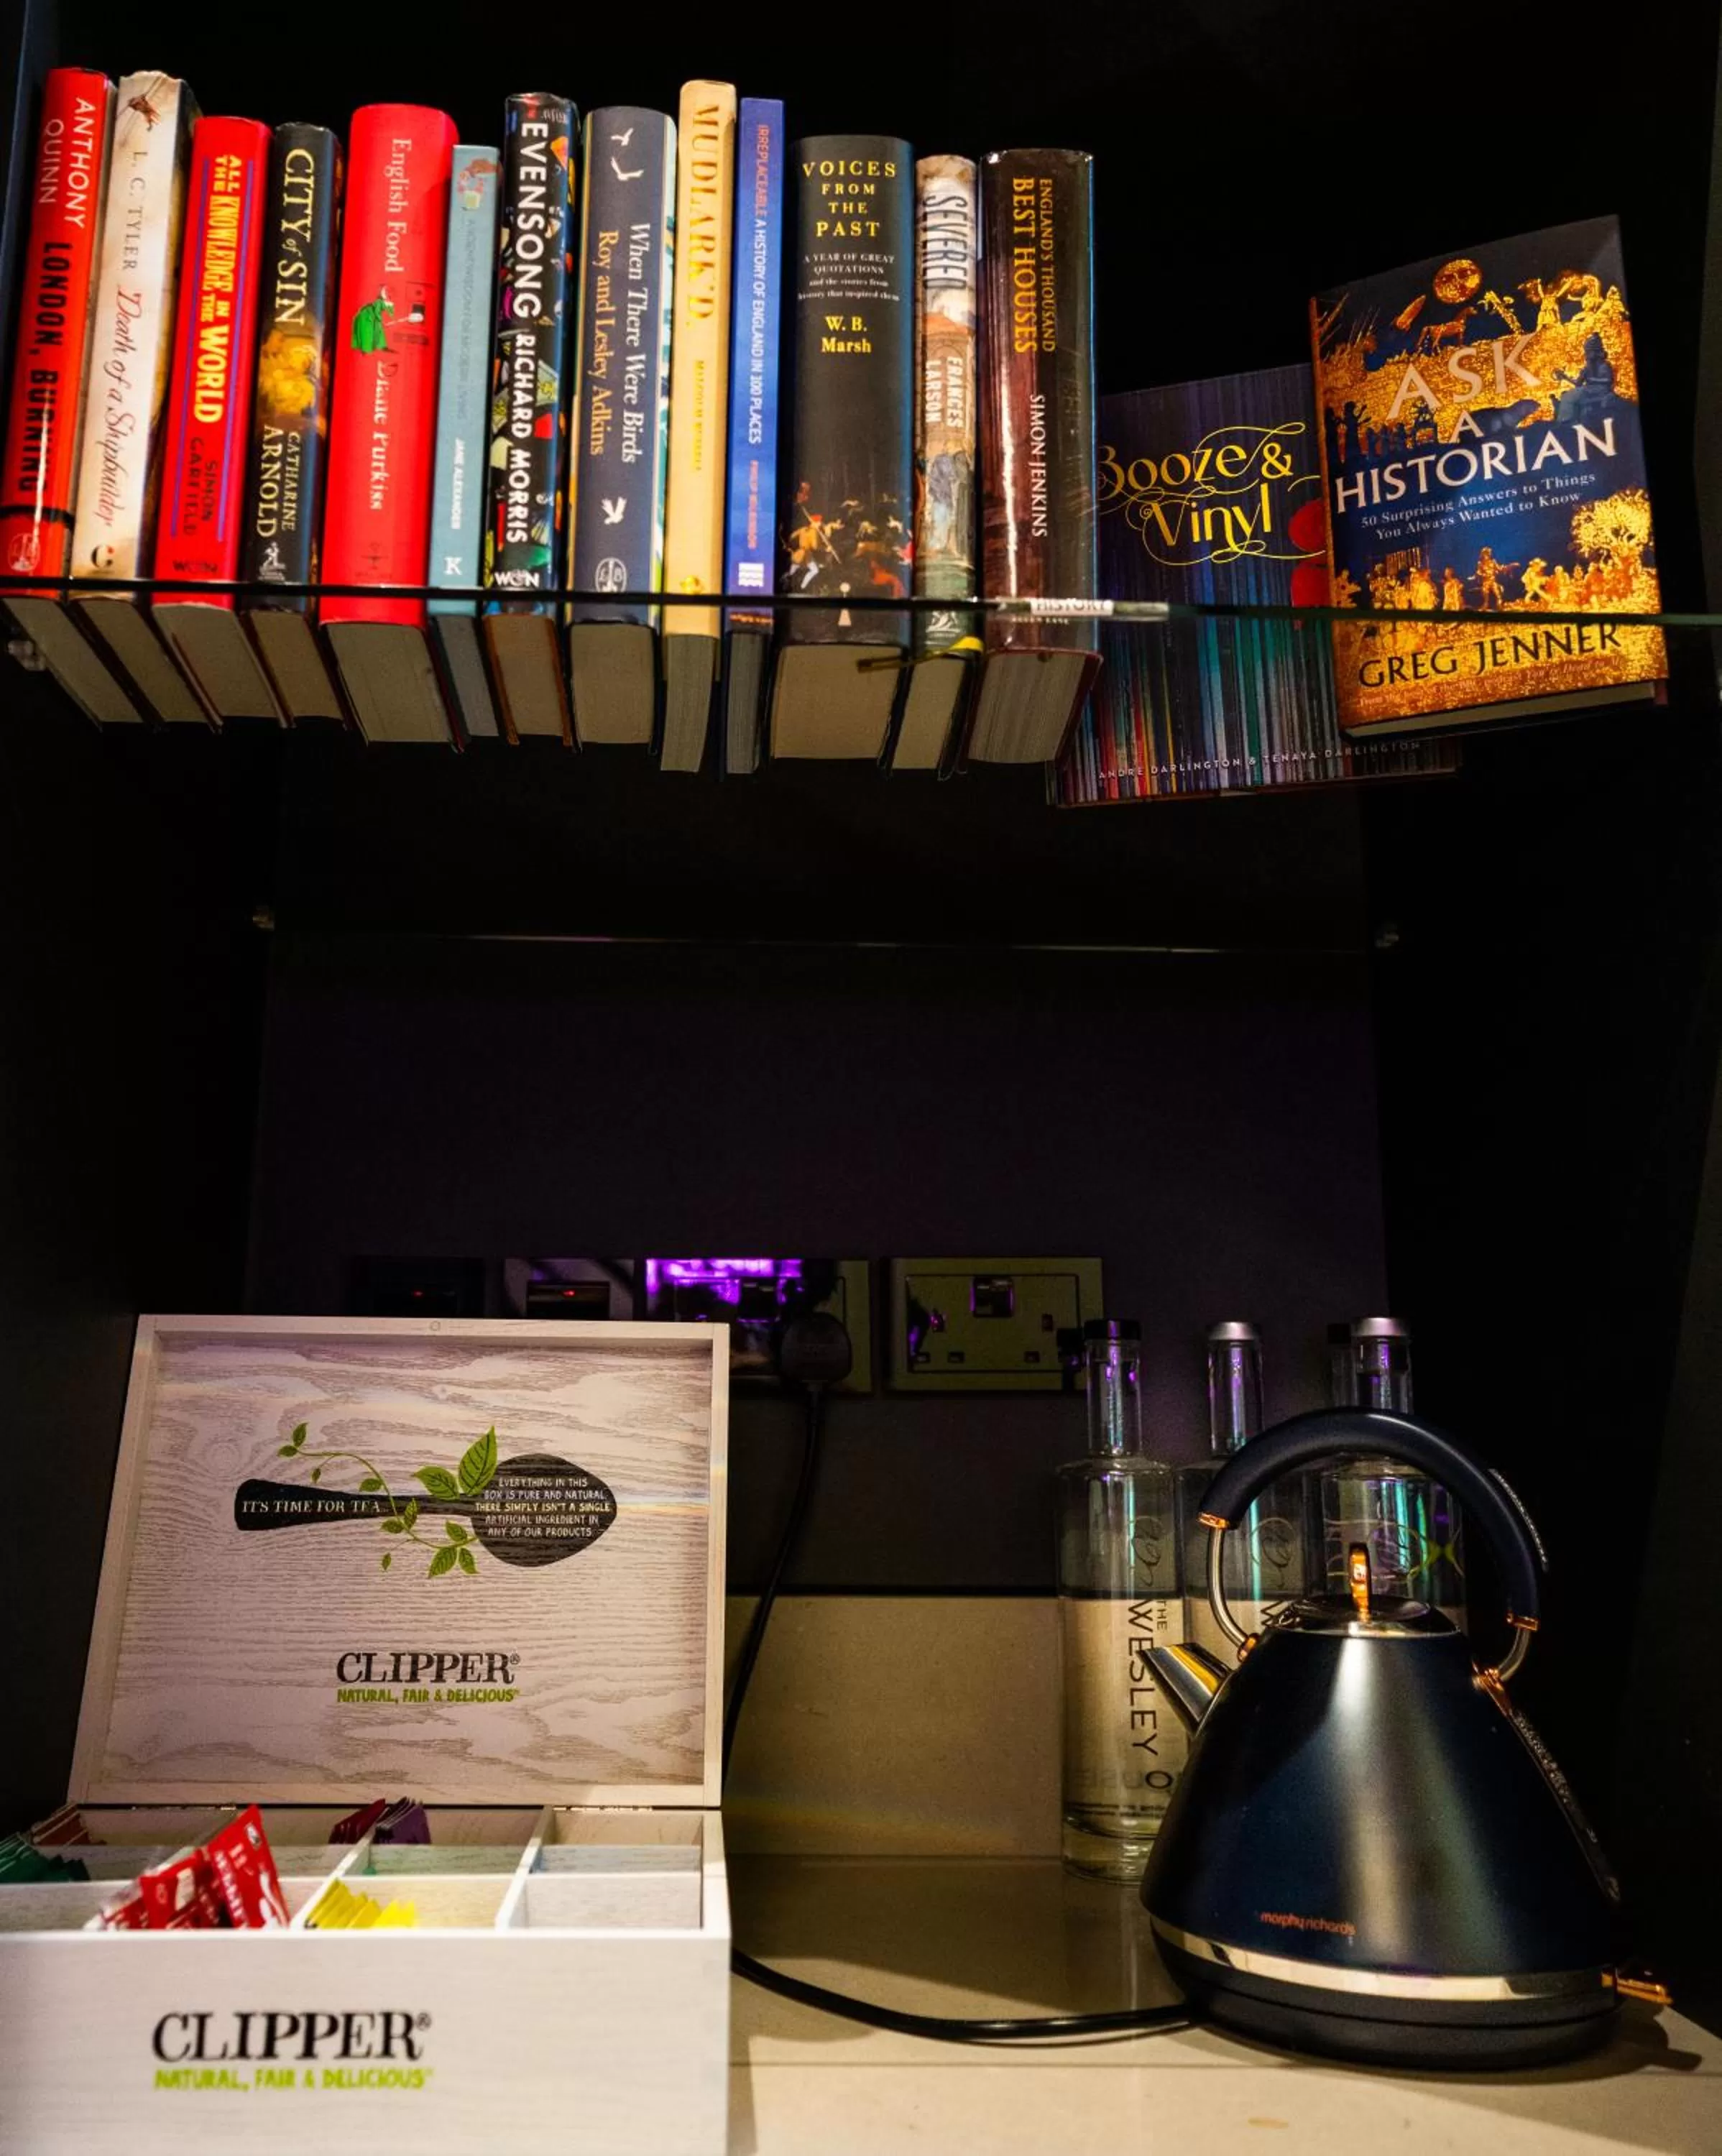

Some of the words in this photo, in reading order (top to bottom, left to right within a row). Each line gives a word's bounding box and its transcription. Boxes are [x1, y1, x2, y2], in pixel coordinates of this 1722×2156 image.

[39, 118, 65, 204] QUINN
[64, 97, 96, 229] ANTHONY
[213, 155, 227, 192] THE
[227, 155, 242, 193] ALL
[385, 138, 412, 213] English
[754, 124, 770, 216] IRREPLACEABLE
[802, 160, 897, 178] VOICES
[821, 183, 875, 195] FROM
[281, 149, 315, 243] CITY
[512, 122, 548, 318] EVENSONG
[754, 218, 767, 227] A
[828, 201, 868, 214] THE
[1013, 178, 1036, 237] BEST
[1040, 179, 1053, 262] ENGLAND'S
[123, 206, 143, 270] TYLER
[202, 195, 240, 292] KNOWLEDGE
[282, 238, 303, 257] of
[385, 220, 408, 272] Food
[591, 229, 620, 270] Roy
[628, 223, 651, 280] When
[752, 229, 766, 279] HISTORY
[816, 221, 880, 237] PAST
[922, 195, 968, 290] SEVERED
[803, 254, 811, 264] A
[812, 252, 840, 262] YEAR
[842, 252, 858, 262] OF
[860, 252, 895, 264] GREAT
[809, 277, 824, 287] and
[814, 264, 885, 275] QUOTATIONS
[29, 241, 73, 356] LONDON,
[201, 293, 216, 322] THE
[216, 300, 230, 317] IN
[275, 260, 308, 326] SIN
[595, 275, 617, 314] and
[625, 287, 648, 347] There
[752, 281, 765, 297] OF
[844, 290, 878, 299] inspired
[1013, 247, 1038, 354] HOUSES
[1041, 264, 1056, 352] THOUSAND
[114, 284, 142, 355] Death
[751, 299, 765, 357] ENGLAND
[821, 336, 872, 353] Marsh
[825, 316, 846, 331] W.
[851, 316, 867, 331] B.
[103, 358, 132, 392] of
[193, 325, 230, 423] WORLD
[588, 318, 616, 379] Lesley
[752, 361, 765, 372] IN
[1386, 332, 1544, 420] ASK
[107, 391, 123, 403] a
[511, 333, 536, 439] RICHARD
[623, 353, 647, 405] Were
[751, 374, 765, 395] 100
[925, 359, 941, 423] LARSON
[947, 356, 963, 428] FRANCES
[19, 369, 59, 494] BURNING
[590, 384, 612, 456] Adkins
[622, 408, 645, 464] Birds
[749, 398, 763, 444] PLACES
[1029, 394, 1046, 456] SIMON
[1450, 410, 1485, 443] A
[93, 406, 136, 528] Shipbuilder
[183, 437, 204, 536] GARFIELD
[201, 461, 218, 522] SIMON
[257, 425, 285, 538] ARNOLD
[281, 432, 301, 531] CATHARINE
[1098, 440, 1249, 501] Booze
[1261, 441, 1293, 479] &
[1335, 418, 1618, 514] HISTORIAN
[505, 448, 532, 543] MORRIS
[1029, 460, 1048, 538] JENKINS
[1141, 482, 1272, 563] Vinyl
[1360, 516, 1377, 529] 50
[1381, 500, 1454, 523] Surprising
[1457, 488, 1519, 508] Answers
[1522, 484, 1538, 495] to
[1541, 473, 1596, 491] Things
[1374, 528, 1401, 541] You
[1406, 515, 1456, 534] Always
[1458, 502, 1514, 522] Wanted
[1519, 499, 1534, 510] to
[1538, 492, 1582, 507] Know
[444, 557, 463, 576] K
[1358, 645, 1458, 688] GREG
[1473, 624, 1621, 676] JENNER
[1151, 758, 1240, 774] DARLINGTON
[1248, 757, 1256, 765] &
[1263, 752, 1317, 763] TENAYA
[1325, 741, 1421, 758] DARLINGTON
[241, 1499, 269, 1514] IT'S
[272, 1499, 313, 1513] TIME
[316, 1499, 345, 1512] FOR
[475, 1502, 501, 1512] THERE
[504, 1502, 539, 1512] SIMPLY
[541, 1502, 566, 1512] ISN'T
[568, 1502, 576, 1512] A
[579, 1502, 610, 1512] SINGLE
[483, 1490, 502, 1500] BOX
[505, 1490, 515, 1500] IS
[518, 1490, 540, 1500] PURE
[543, 1489, 562, 1500] AND
[498, 1478, 553, 1488] EVERYTHING
[555, 1477, 566, 1487] IN
[568, 1477, 588, 1487] THIS
[484, 1514, 532, 1524] ARTIFICIAL
[535, 1514, 586, 1524] INGREDIENT
[588, 1514, 599, 1525] IN
[487, 1527, 507, 1536] ANY
[509, 1527, 521, 1536] OF
[524, 1527, 542, 1536] OUR
[1157, 1600, 1168, 1631] THE
[336, 1689, 399, 1704] NATURAL,
[402, 1689, 430, 1703] FAIR
[433, 1690, 442, 1703] &
[1128, 1599, 1159, 1756] WESLEY
[153, 2068, 250, 2092] NATURAL,
[254, 2068, 295, 2089] FAIR
[303, 2069, 316, 2090] &
